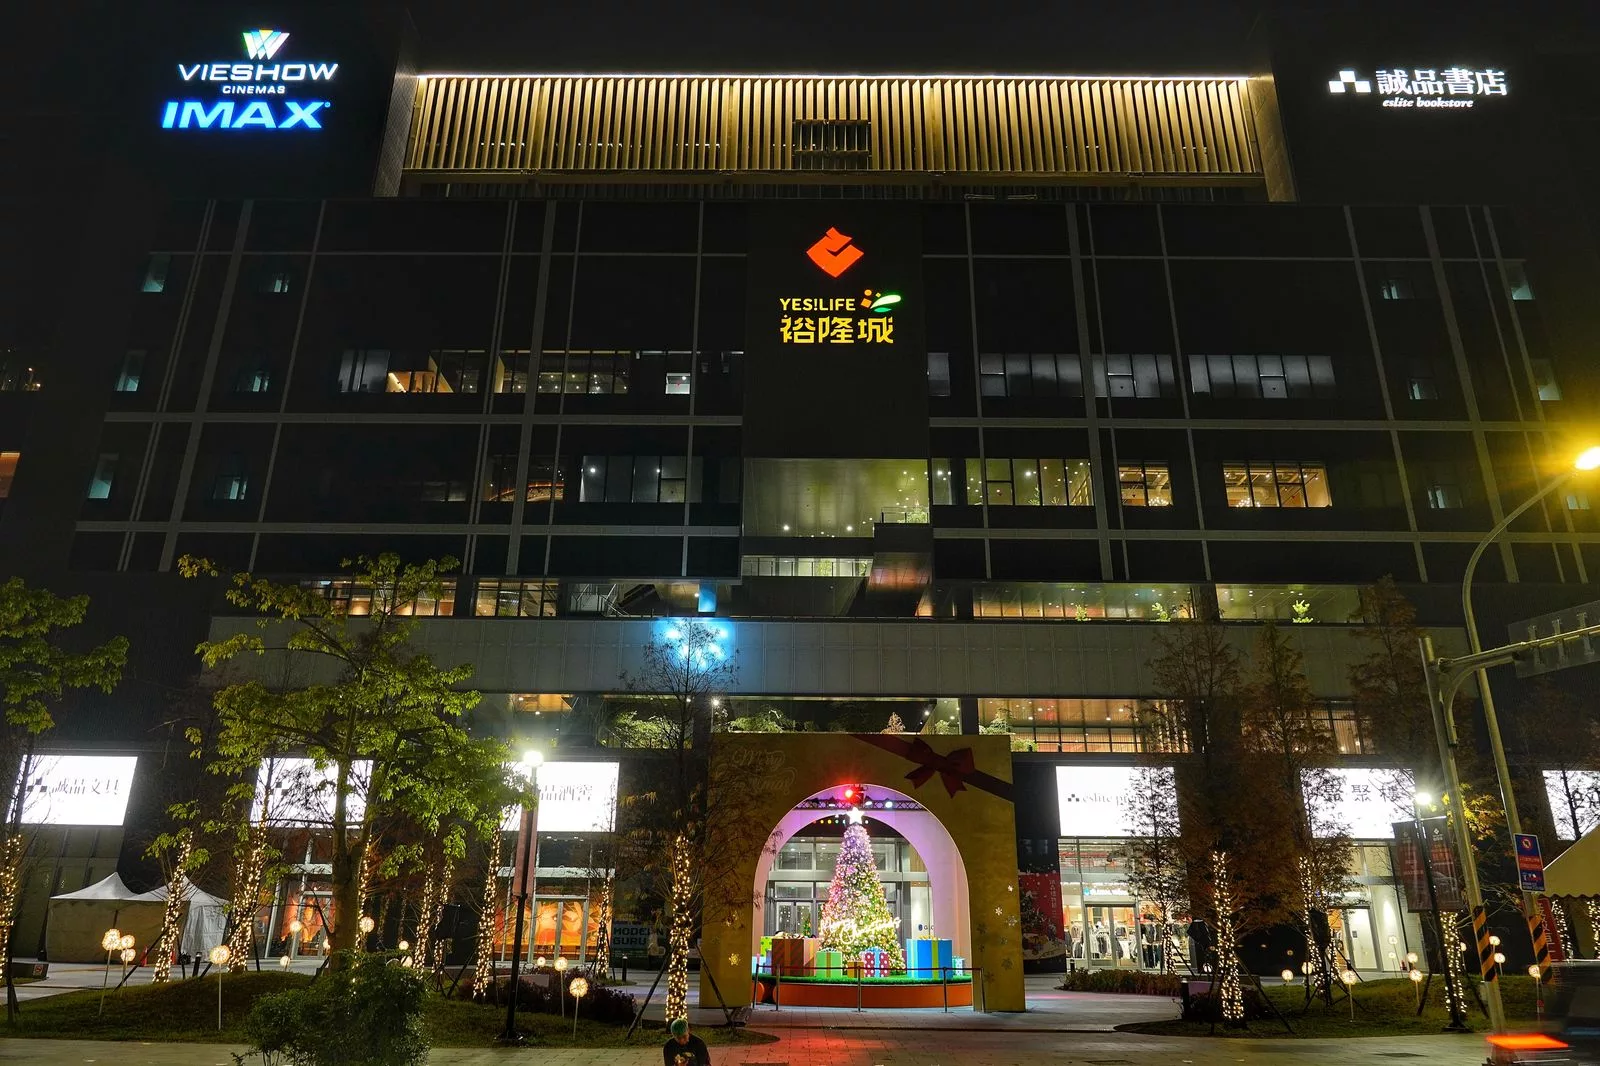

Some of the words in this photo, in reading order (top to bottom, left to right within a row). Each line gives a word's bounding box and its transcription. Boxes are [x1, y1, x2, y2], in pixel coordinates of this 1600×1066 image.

[178, 63, 339, 81] VIESHOW
[1375, 67, 1508, 96] 誠品書店
[222, 85, 286, 94] CINEMAS
[1382, 97, 1414, 108] eslite
[1416, 97, 1474, 108] bookstore
[780, 298, 856, 311] YES!LIFE
[780, 314, 894, 344] 裕隆城
[529, 784, 593, 801] 品酒窖
[1082, 793, 1113, 803] eslite
[613, 927, 665, 936] MODEN
